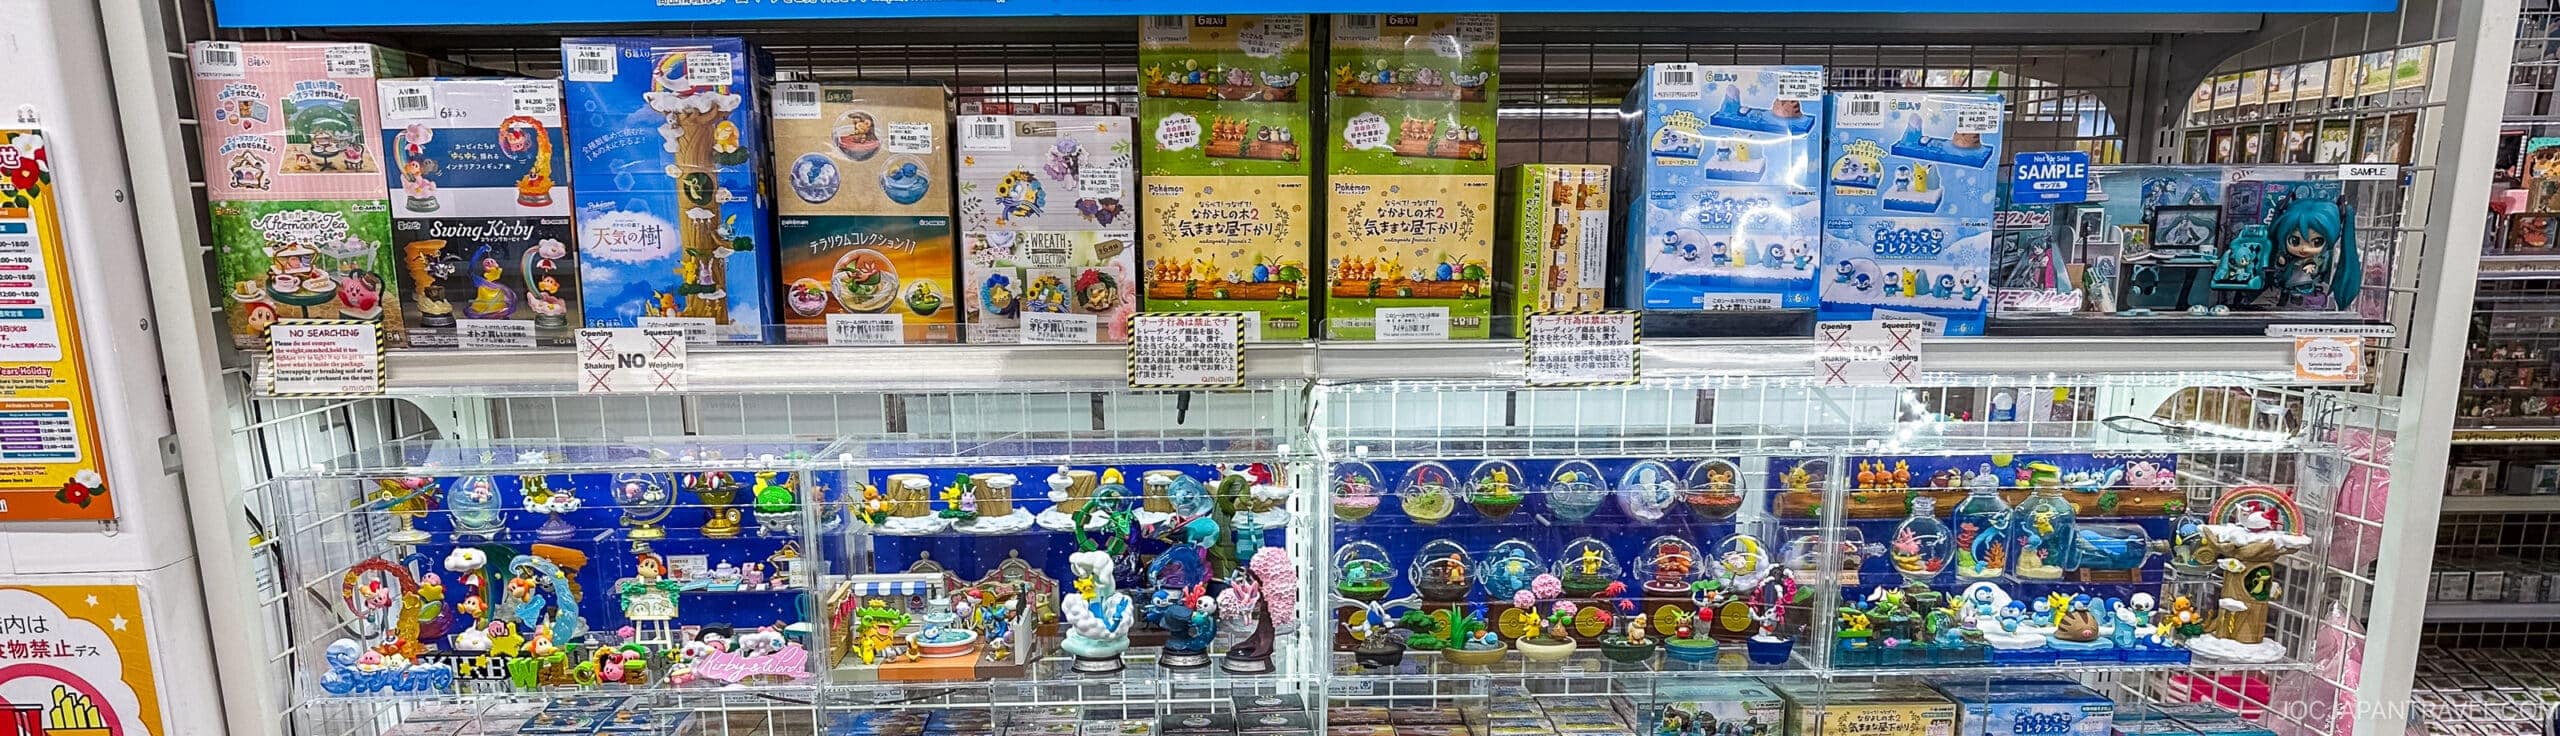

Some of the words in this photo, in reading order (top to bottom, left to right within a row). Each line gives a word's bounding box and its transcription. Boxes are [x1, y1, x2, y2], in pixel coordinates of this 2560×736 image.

[2018, 163, 2085, 180] SAMPLE
[2350, 167, 2387, 176] SAMPLE
[252, 212, 321, 231] Afternoon
[319, 212, 348, 230] Tea
[1364, 218, 1458, 236] 気ままな昼下がり
[430, 220, 483, 242] Swing
[483, 219, 534, 241] Kirby
[1178, 219, 1273, 238] 気ままな昼下がり
[591, 225, 664, 250] 天気の樹
[1031, 233, 1066, 249] WREATH
[1877, 229, 1930, 241] ポッチャマ
[1875, 242, 1942, 254] コレクション
[1031, 254, 1067, 264] COLLECTION
[1140, 318, 1230, 327] サーチ行為は禁止です
[1537, 315, 1627, 325] サーチ行為は禁止です
[1821, 323, 1851, 331] Opening
[1881, 322, 1920, 331] Squeezing
[289, 329, 304, 338] NO
[307, 328, 360, 338] SEARCHING
[581, 330, 613, 339] Opening
[643, 329, 683, 338] Squeezing
[584, 362, 615, 370] Shaking
[648, 361, 684, 370] Weighing
[617, 353, 646, 369] NO
[20, 367, 52, 377] Holiday
